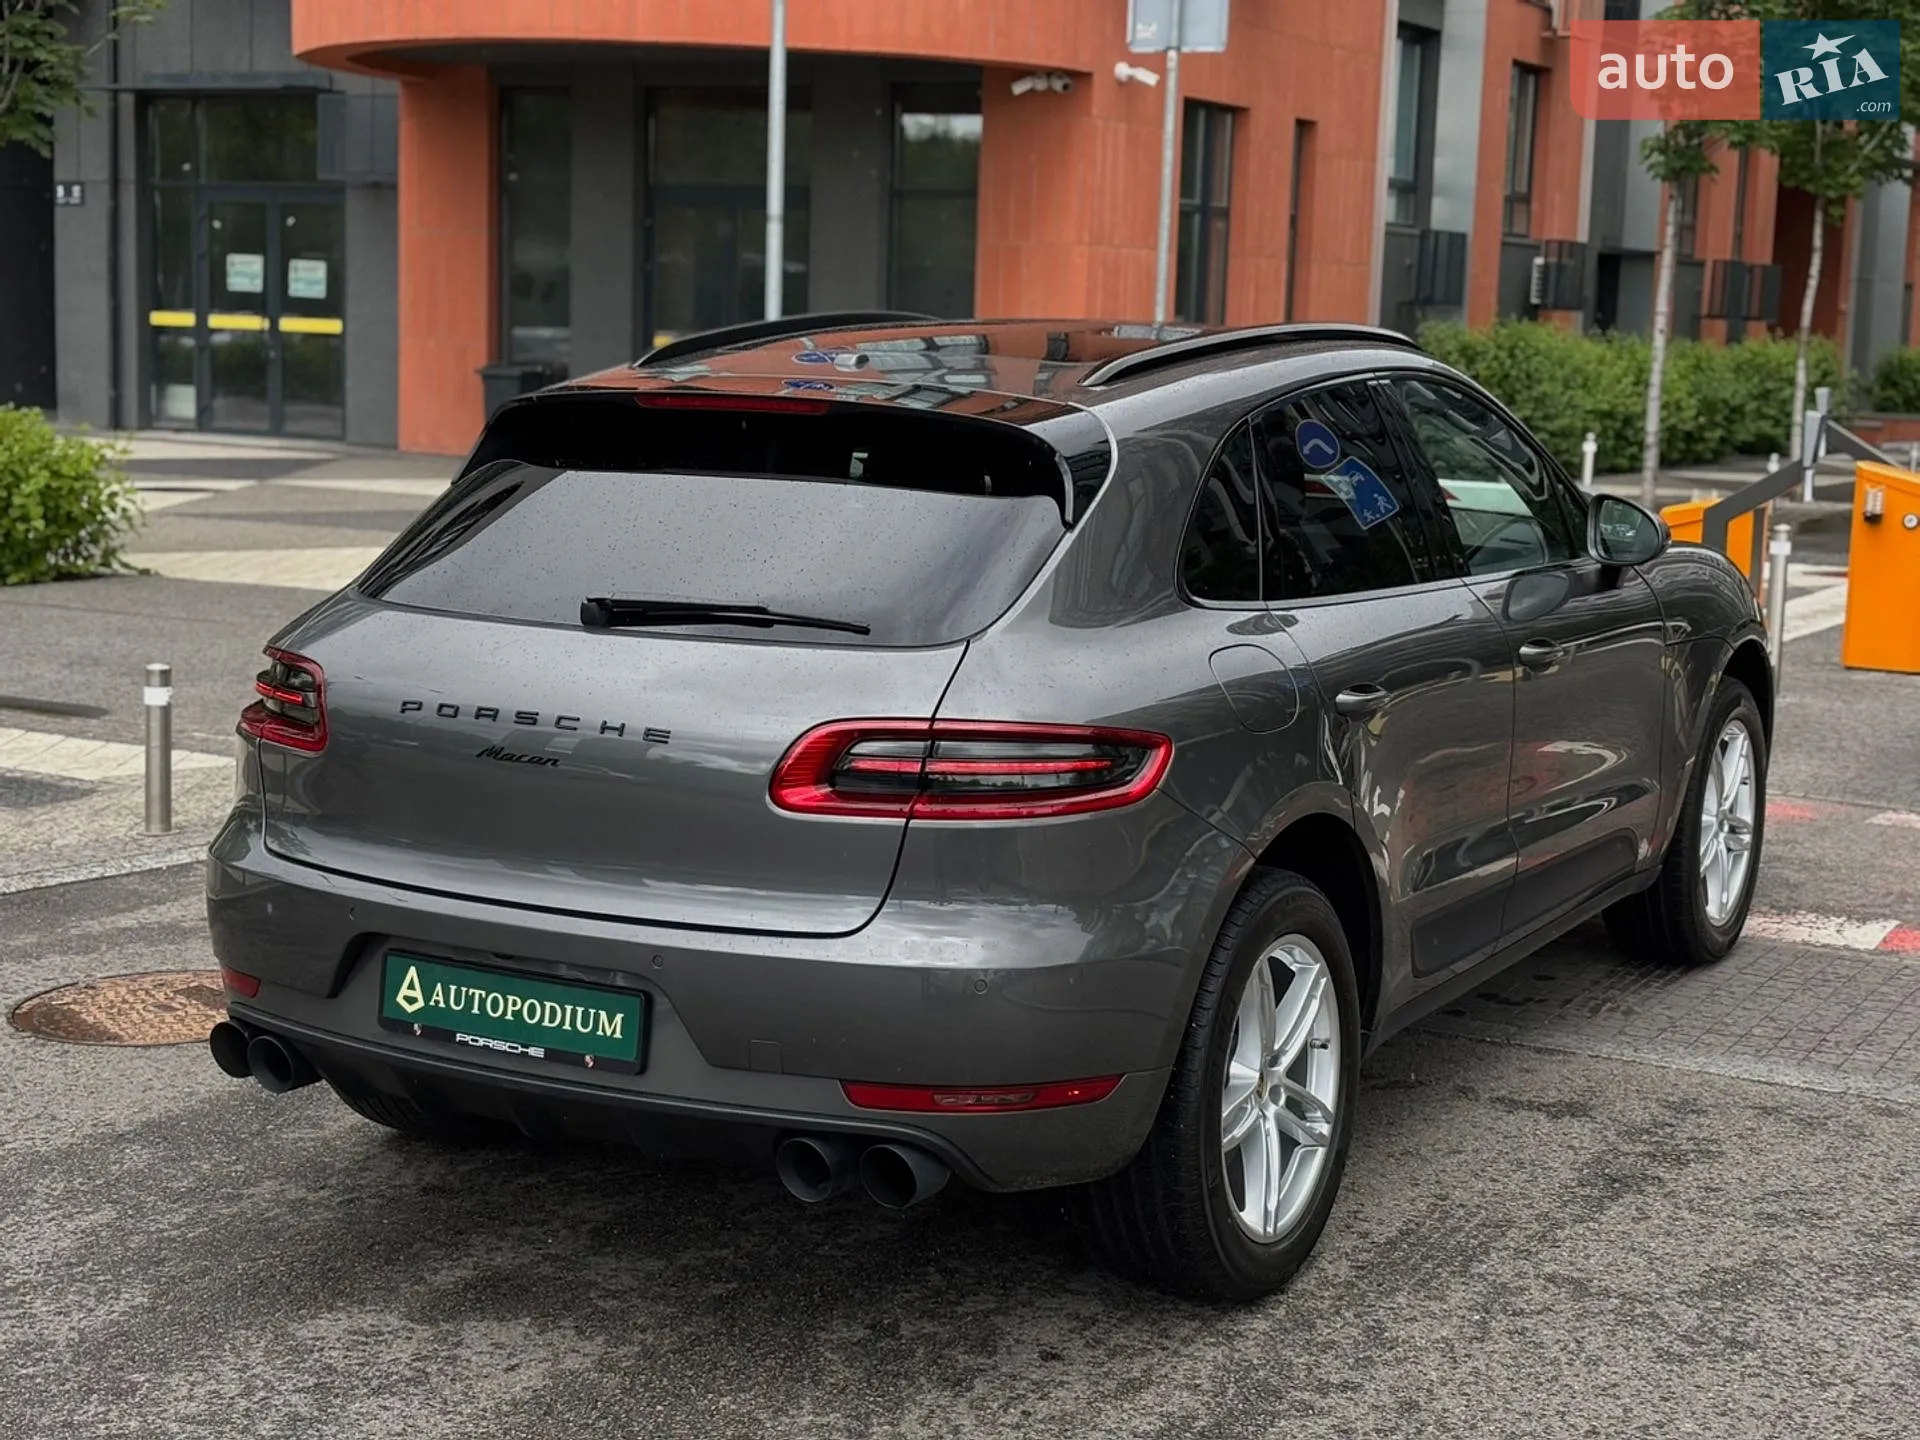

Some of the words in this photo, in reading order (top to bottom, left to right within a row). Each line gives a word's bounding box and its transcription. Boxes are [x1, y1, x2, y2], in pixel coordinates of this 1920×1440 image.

[400, 700, 672, 745] PORSCHE
[475, 745, 560, 768] Macan
[429, 982, 625, 1039] AUTOPODIUM
[455, 1033, 546, 1058] PORSCHE
